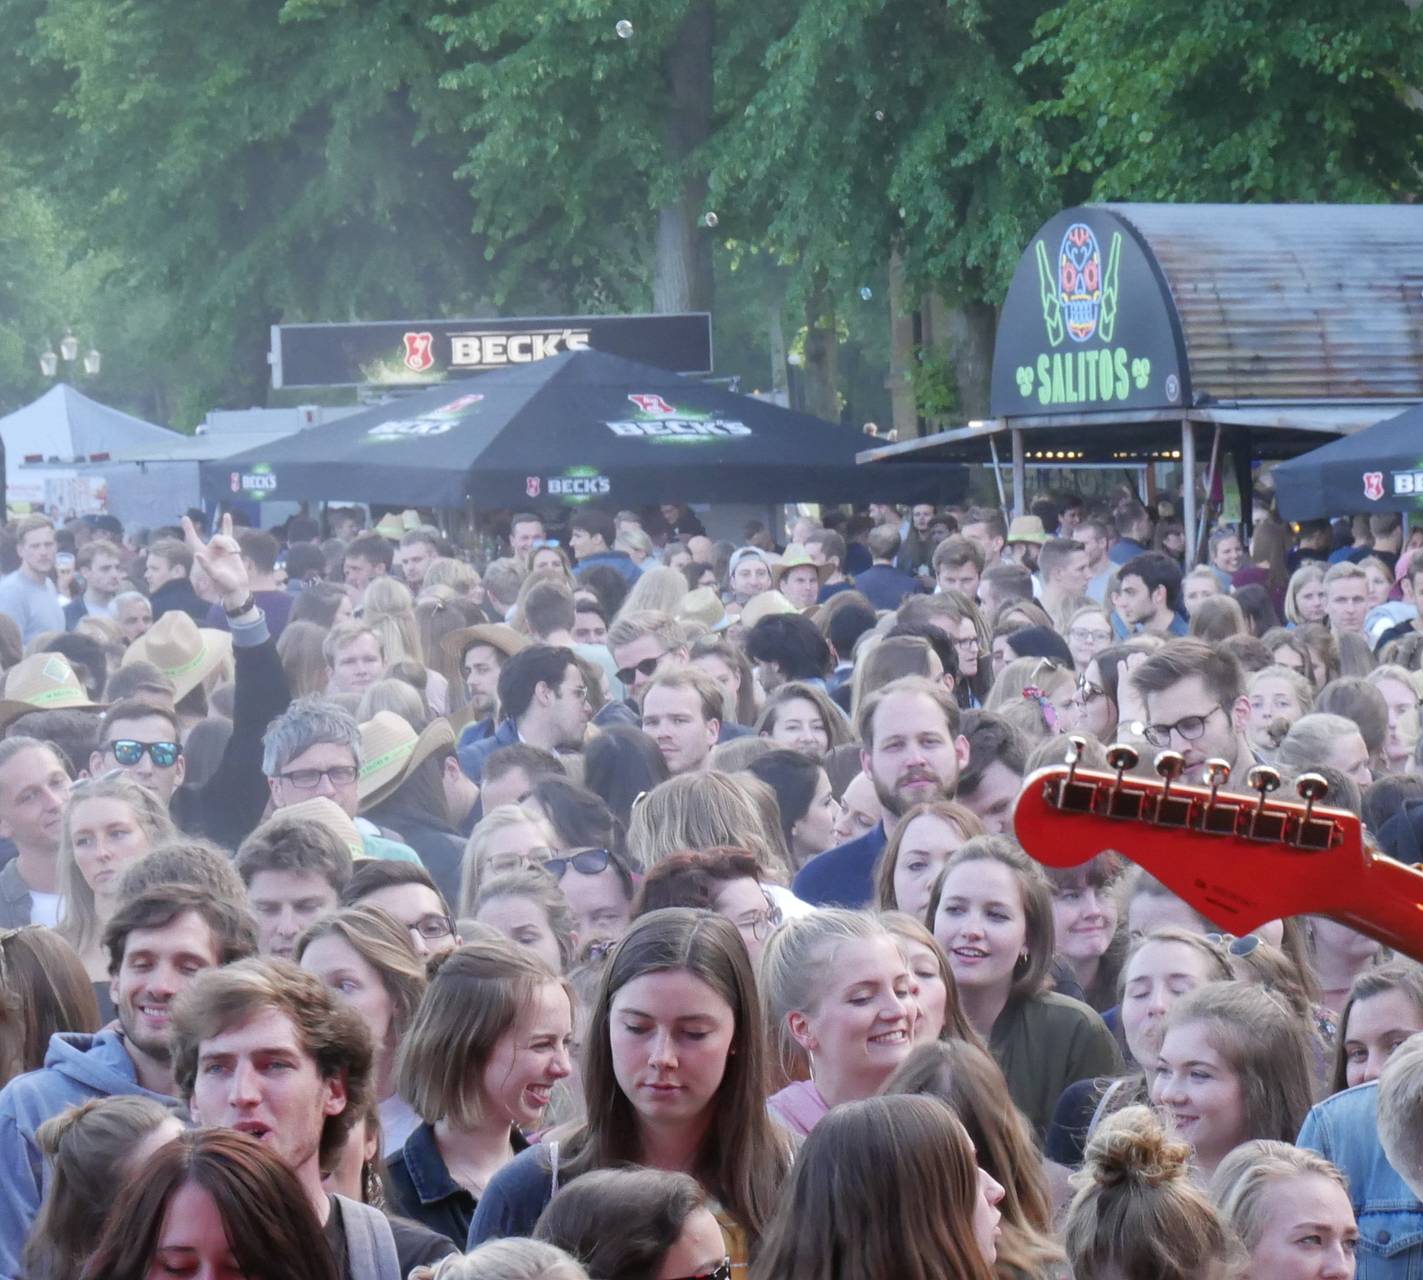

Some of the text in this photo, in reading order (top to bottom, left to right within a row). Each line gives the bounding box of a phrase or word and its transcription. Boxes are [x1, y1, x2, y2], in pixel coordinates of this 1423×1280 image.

[1037, 347, 1130, 405] SALITOS
[606, 420, 752, 436] BECK'S
[548, 476, 610, 495] BECK'S
